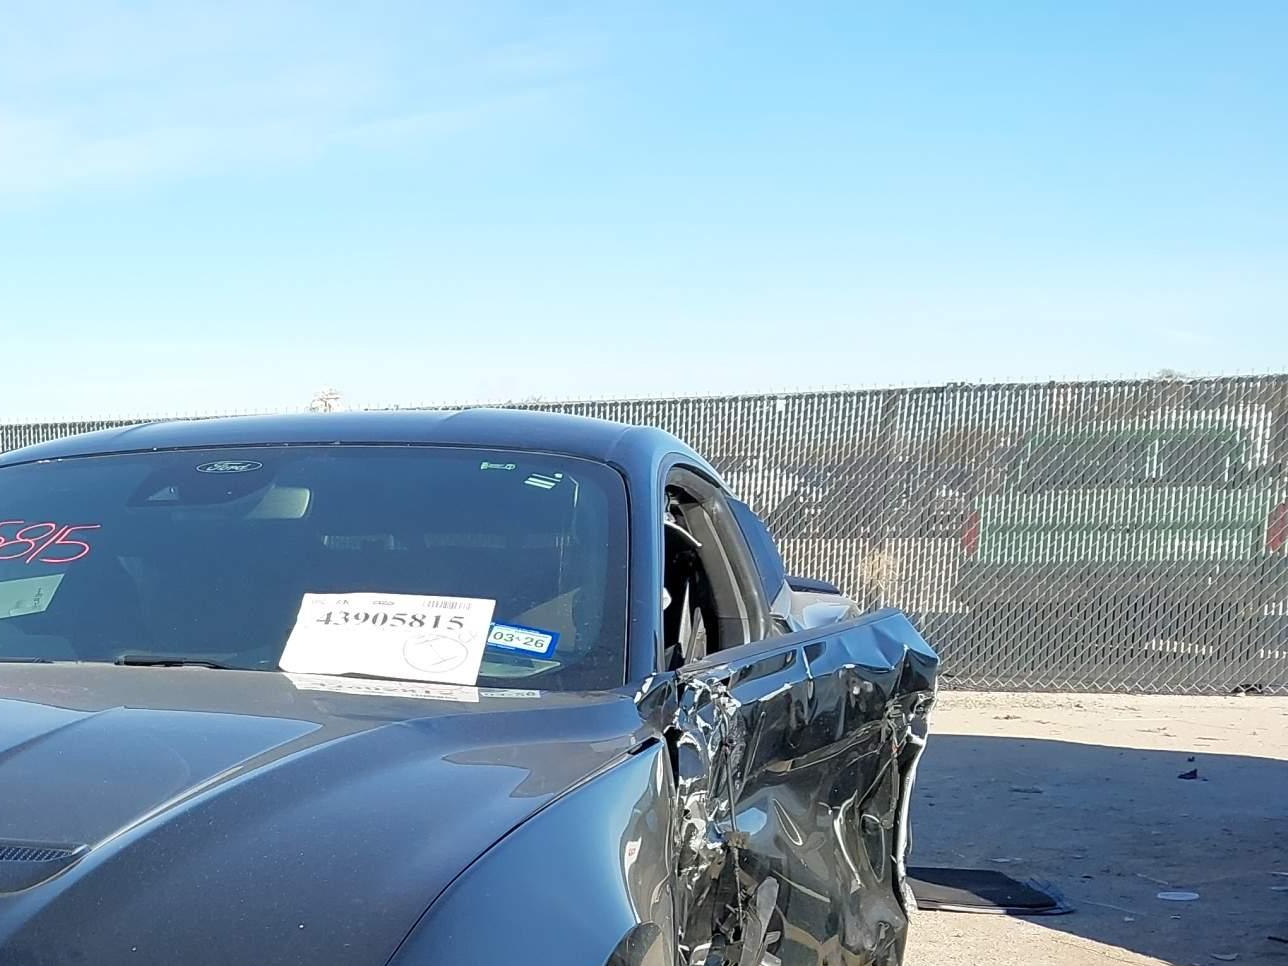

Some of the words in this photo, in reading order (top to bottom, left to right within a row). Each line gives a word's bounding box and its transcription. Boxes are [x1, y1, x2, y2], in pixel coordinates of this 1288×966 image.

[315, 610, 466, 631] 43905815
[493, 631, 515, 643] 03
[522, 636, 545, 649] 26
